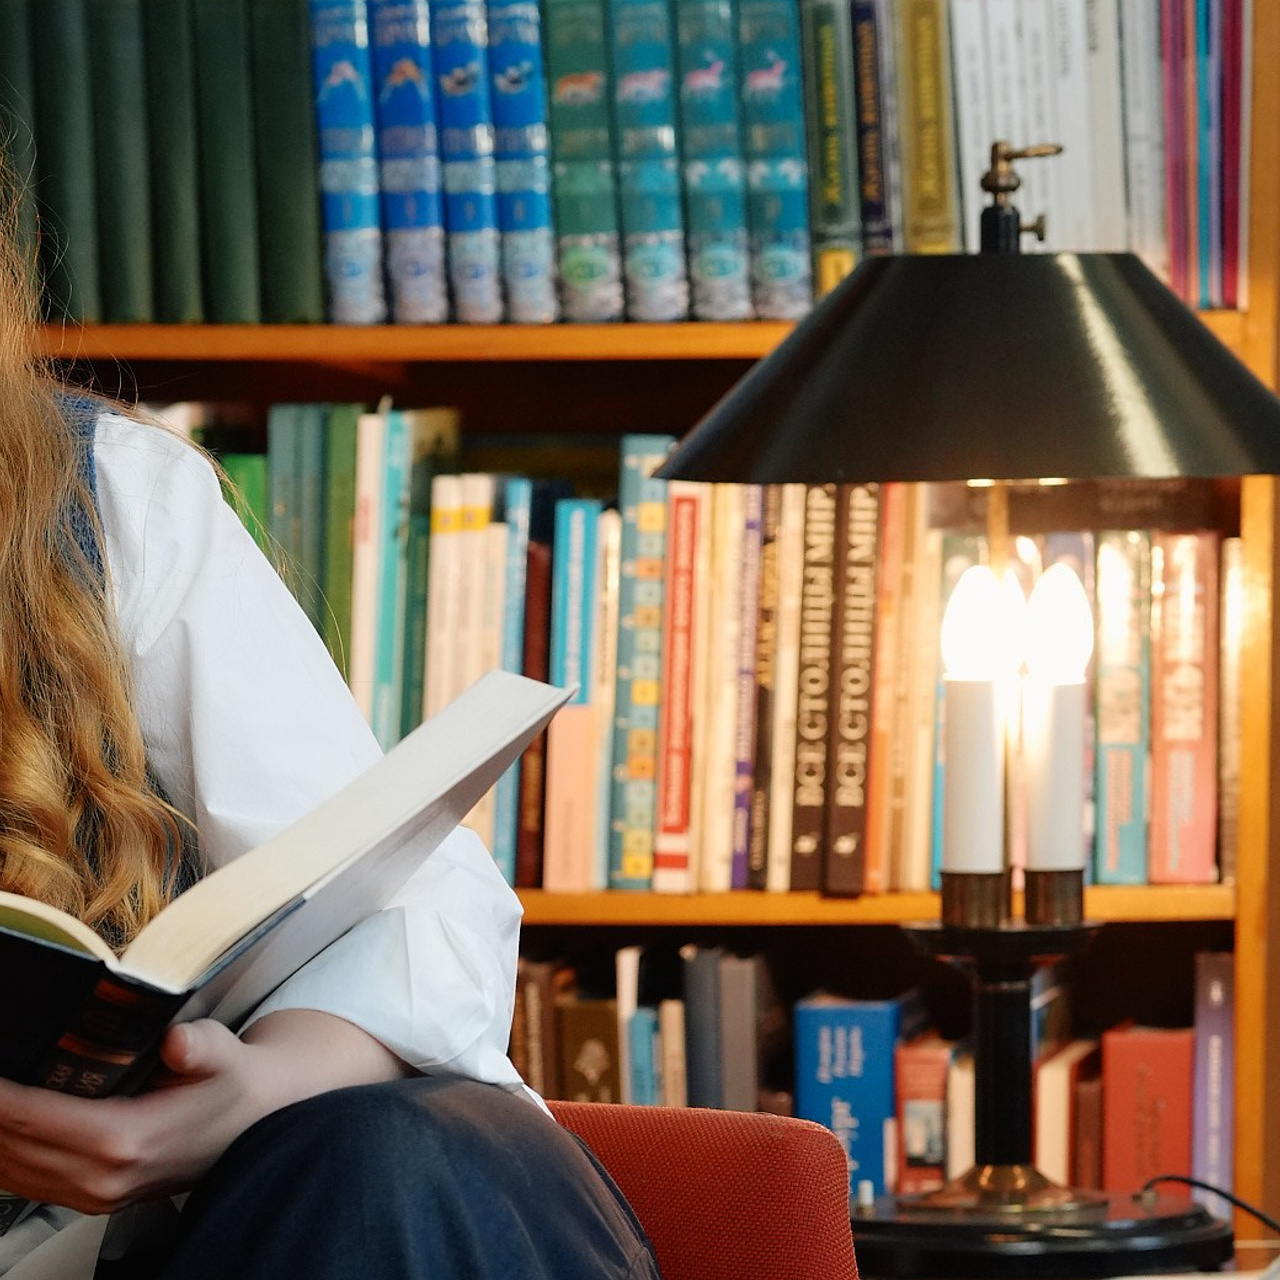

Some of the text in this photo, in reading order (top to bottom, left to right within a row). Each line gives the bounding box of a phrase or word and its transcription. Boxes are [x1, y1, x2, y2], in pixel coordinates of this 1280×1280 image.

[804, 484, 838, 563] МИР
[847, 484, 879, 563] МИР
[796, 742, 828, 808] ВСЕ
[835, 742, 867, 808] ВСЕ
